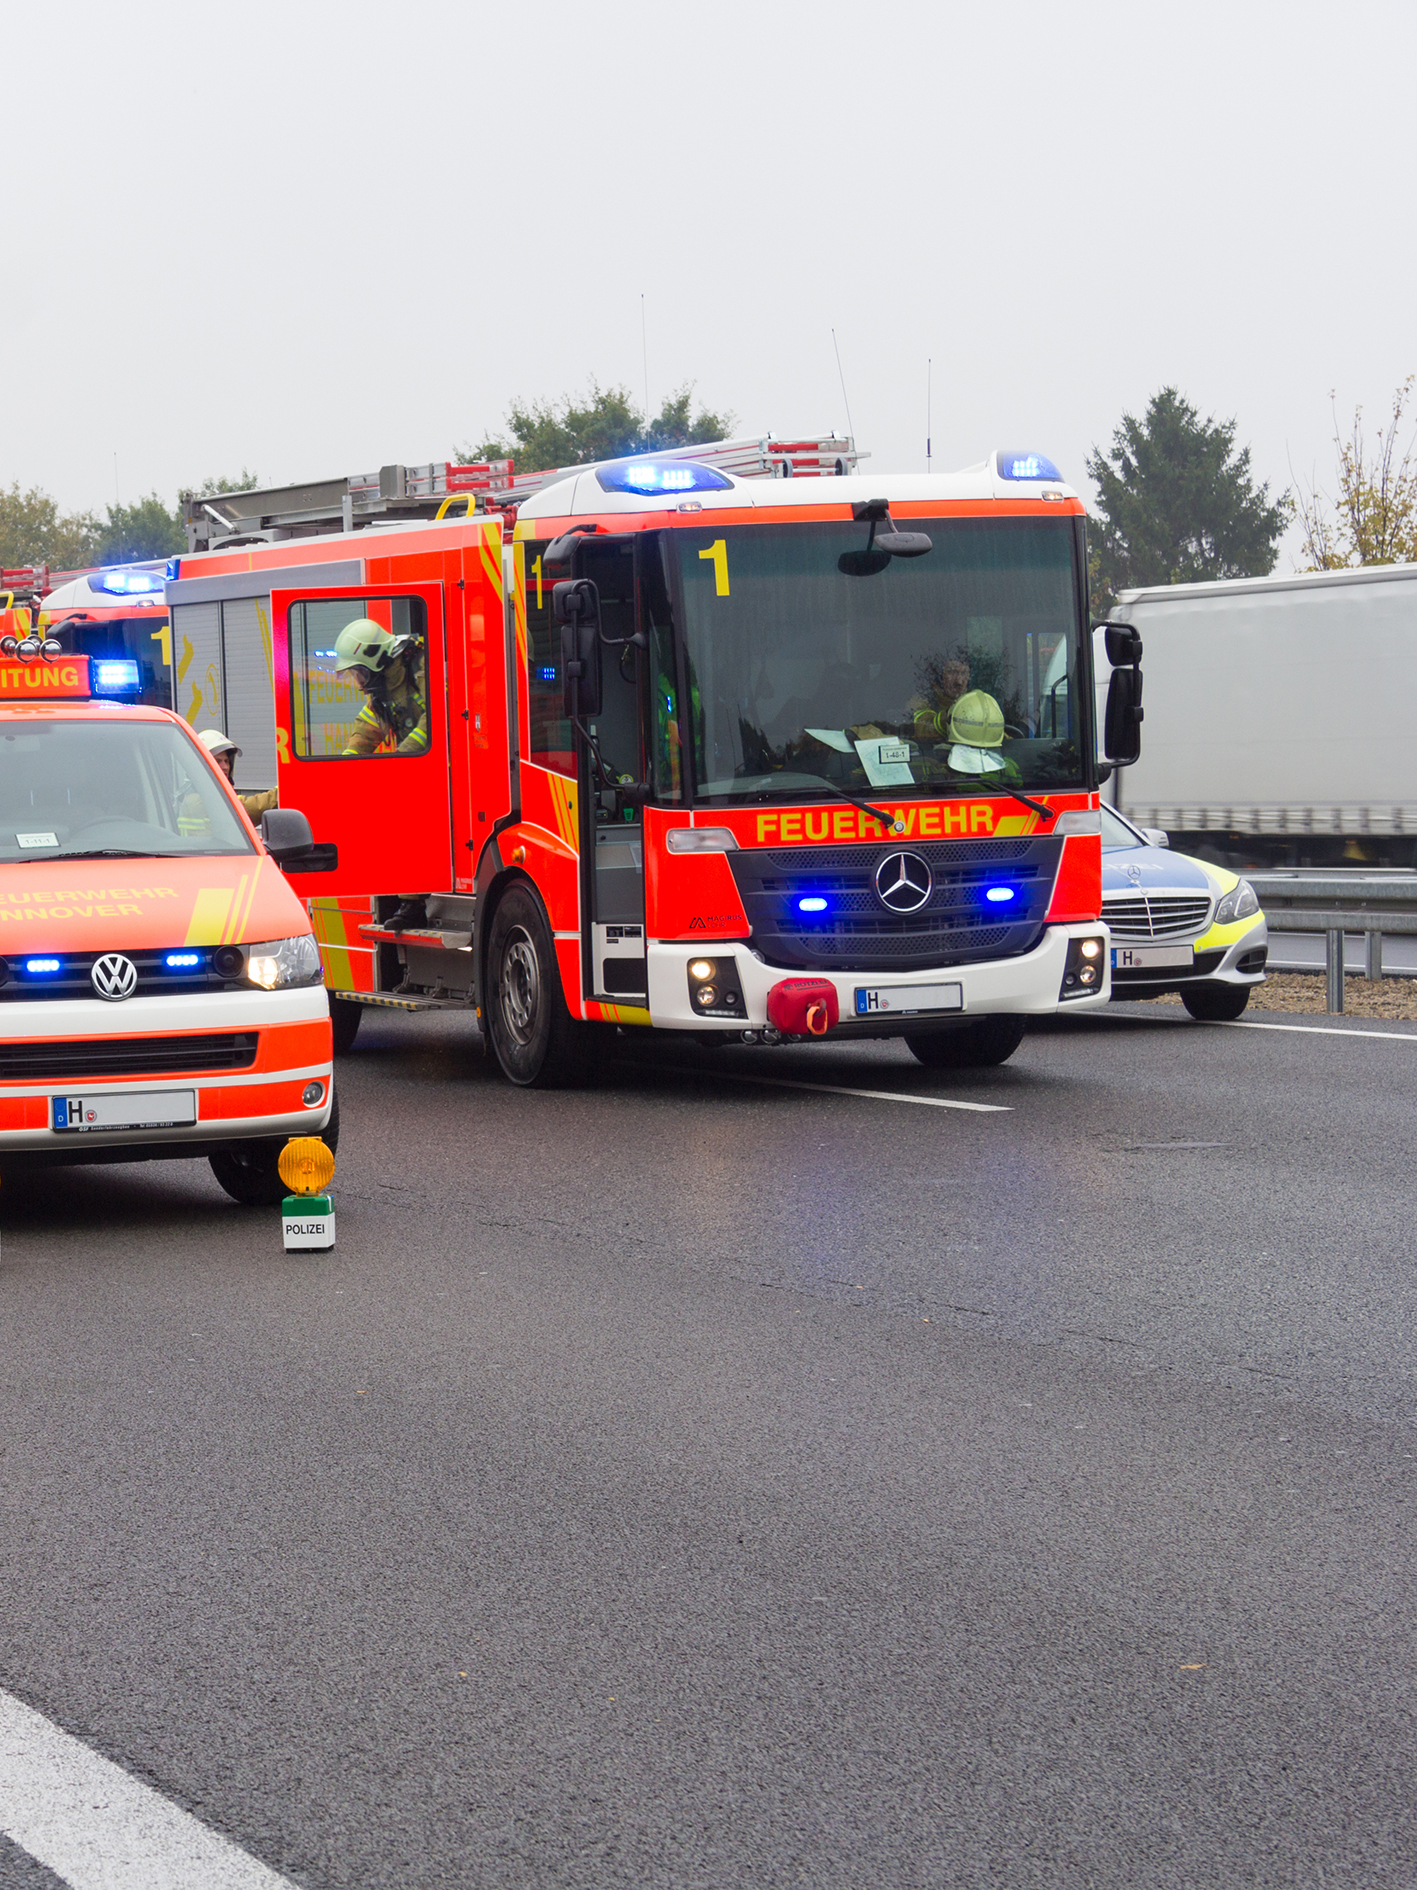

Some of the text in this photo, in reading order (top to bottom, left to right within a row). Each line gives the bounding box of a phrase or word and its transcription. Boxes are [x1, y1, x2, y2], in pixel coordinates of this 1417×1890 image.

[698, 539, 730, 597] 1
[531, 555, 543, 609] 1
[756, 804, 994, 843] FEUERWEHR
[707, 914, 742, 922] MAGIRUS
[1123, 951, 1133, 966] H
[867, 991, 879, 1010] H
[57, 1100, 83, 1124] D H
[286, 1224, 325, 1235] POLIZEI
